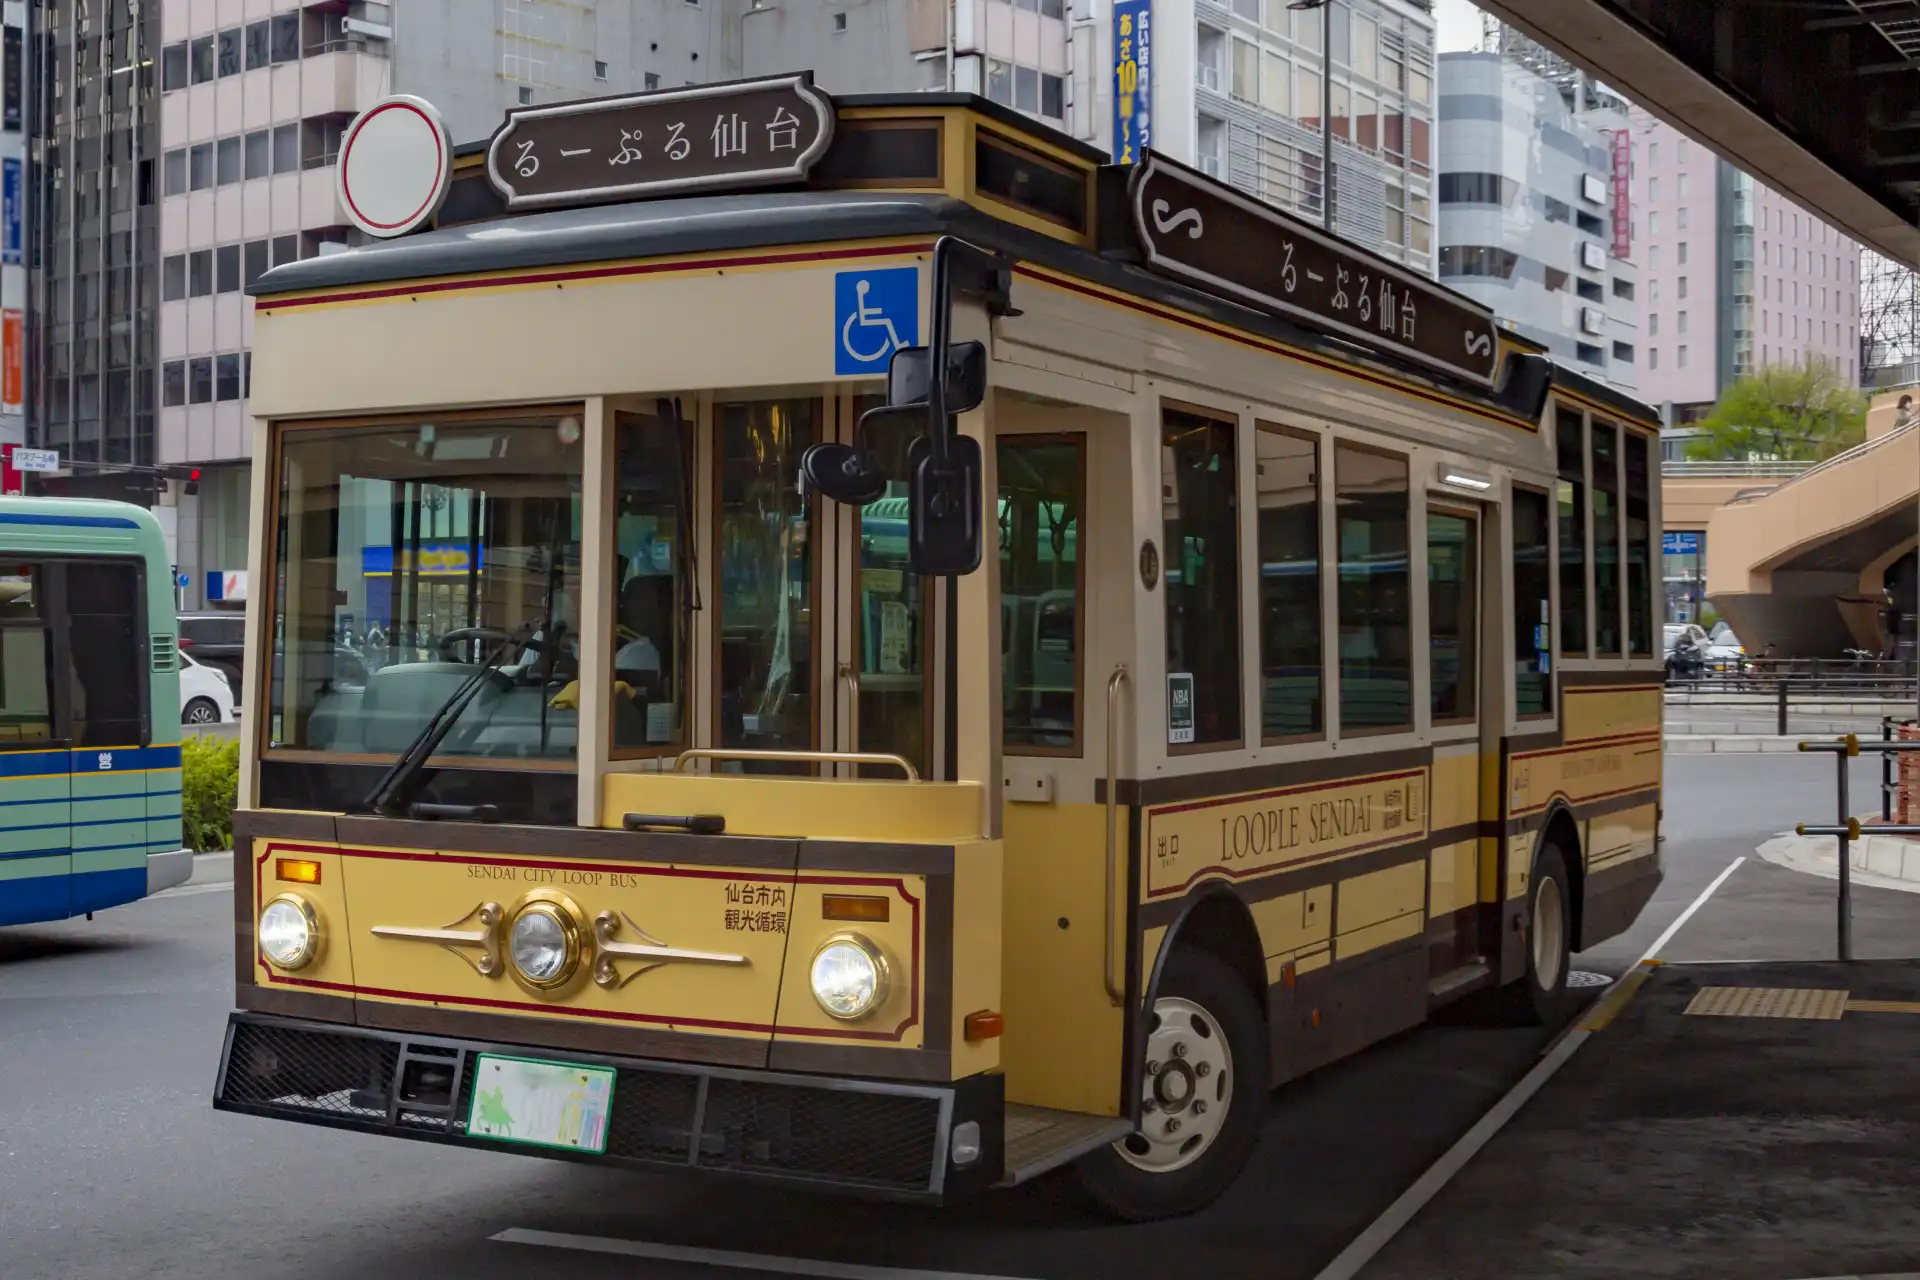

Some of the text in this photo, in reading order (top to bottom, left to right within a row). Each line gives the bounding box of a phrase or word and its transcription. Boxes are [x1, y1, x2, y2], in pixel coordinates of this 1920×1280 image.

[514, 106, 801, 177] るーぷる仙台
[1281, 240, 1416, 342] るーぷる仙台
[1157, 834, 1179, 858] 出口
[1220, 806, 1300, 861] LOOPLE
[1309, 794, 1373, 844] SENDAI
[467, 864, 638, 888] SENDAI CITY LOOP BUS
[724, 881, 785, 908] 仙台市内
